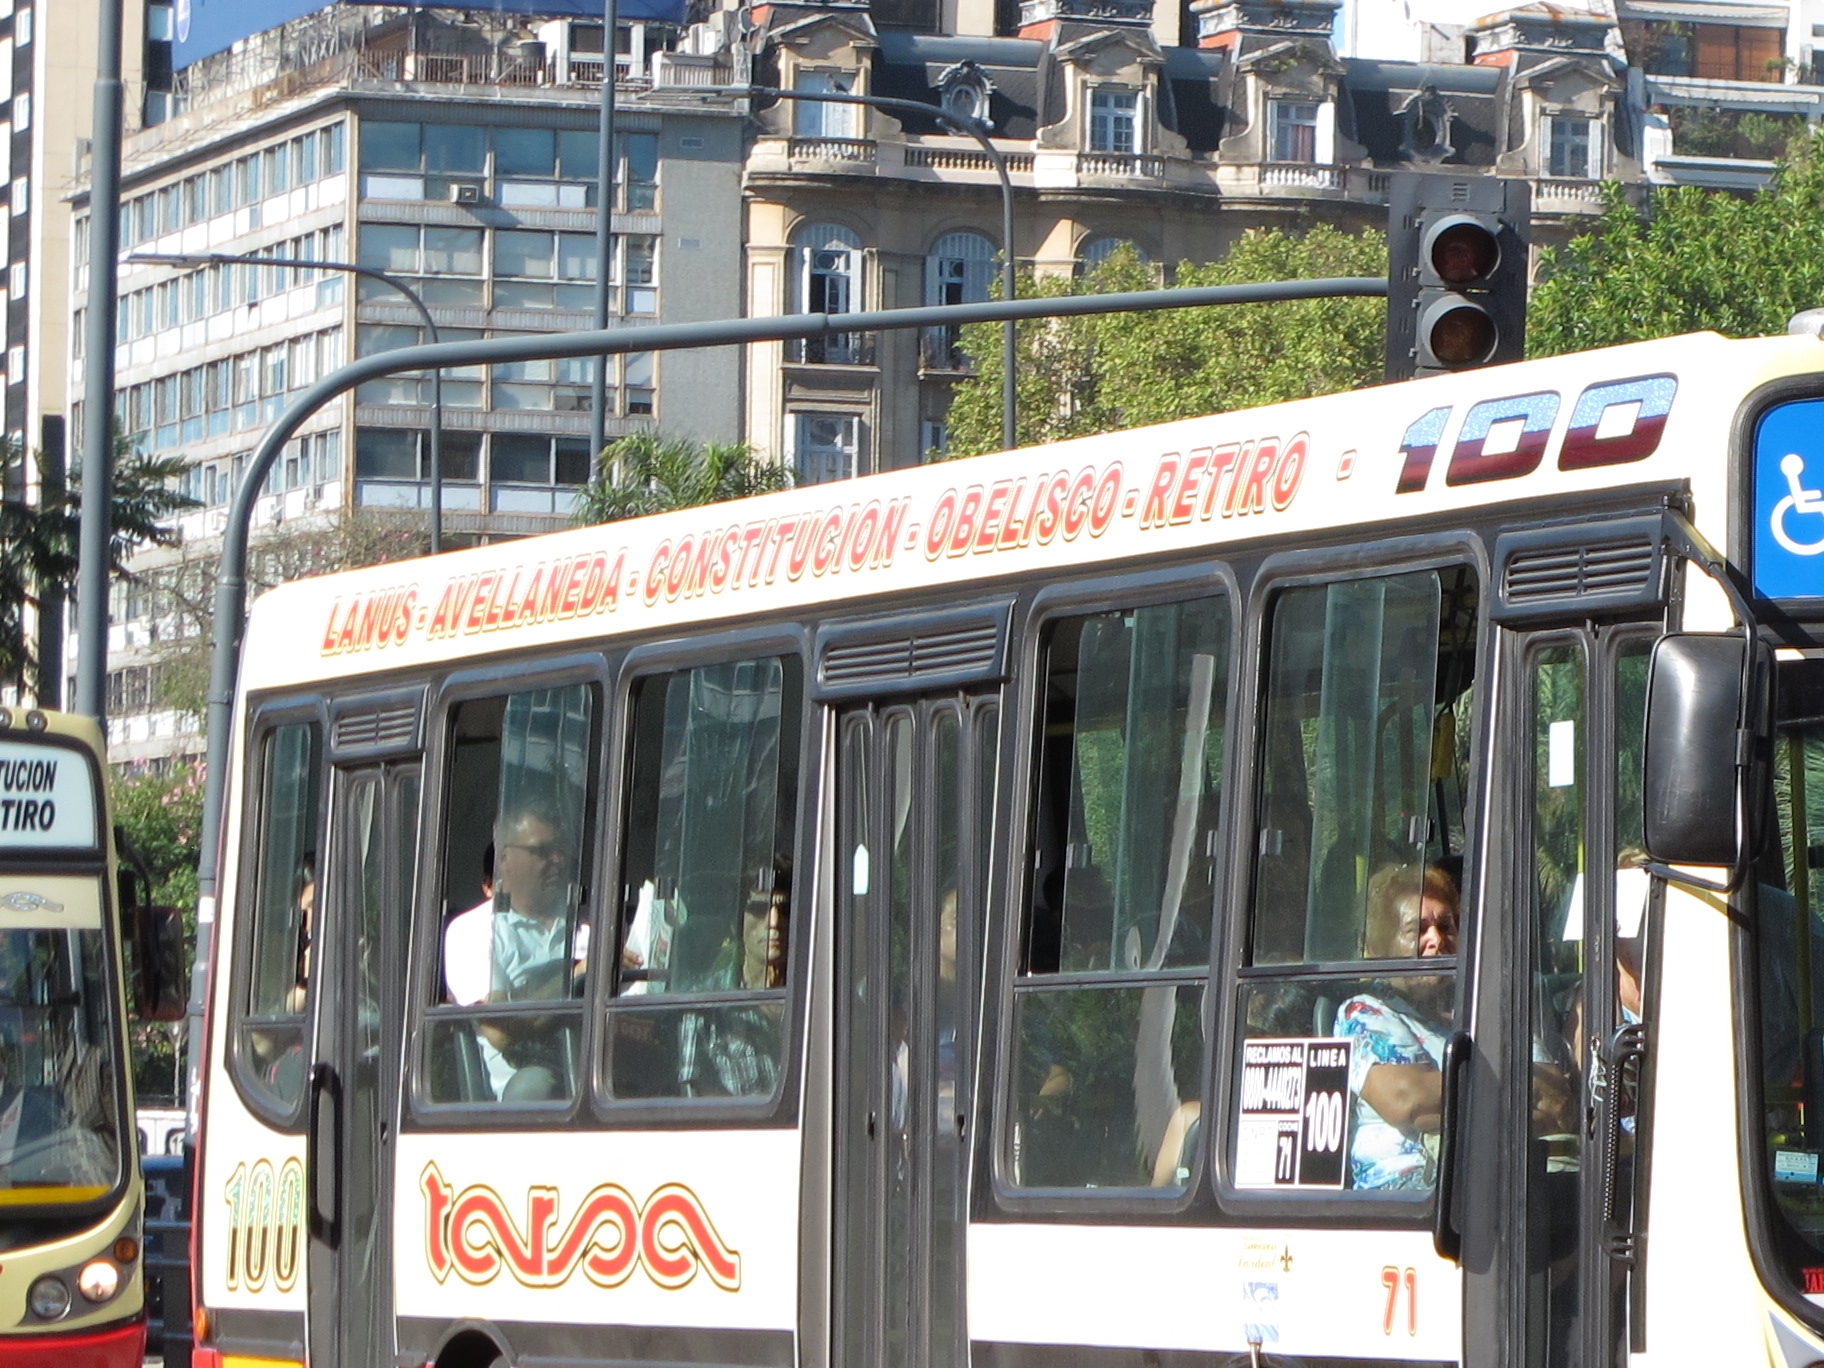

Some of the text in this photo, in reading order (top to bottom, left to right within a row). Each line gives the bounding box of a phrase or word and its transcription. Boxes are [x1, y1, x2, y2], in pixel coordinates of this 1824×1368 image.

[1396, 372, 1678, 494] 100
[320, 581, 418, 656] LANUS
[427, 549, 628, 640] AVELLANEDA
[644, 497, 912, 604] CONSTITUCION
[924, 461, 1124, 561] OBELISCO
[1141, 431, 1311, 529] RETIRO
[1, 799, 56, 832] TIRO
[1246, 1046, 1291, 1064] RECLAMOS
[1309, 1049, 1347, 1067] LINEA
[1305, 1091, 1344, 1153] 100
[1279, 1136, 1293, 1180] 71
[225, 1156, 306, 1293] 100
[1381, 1265, 1418, 1336] 71
